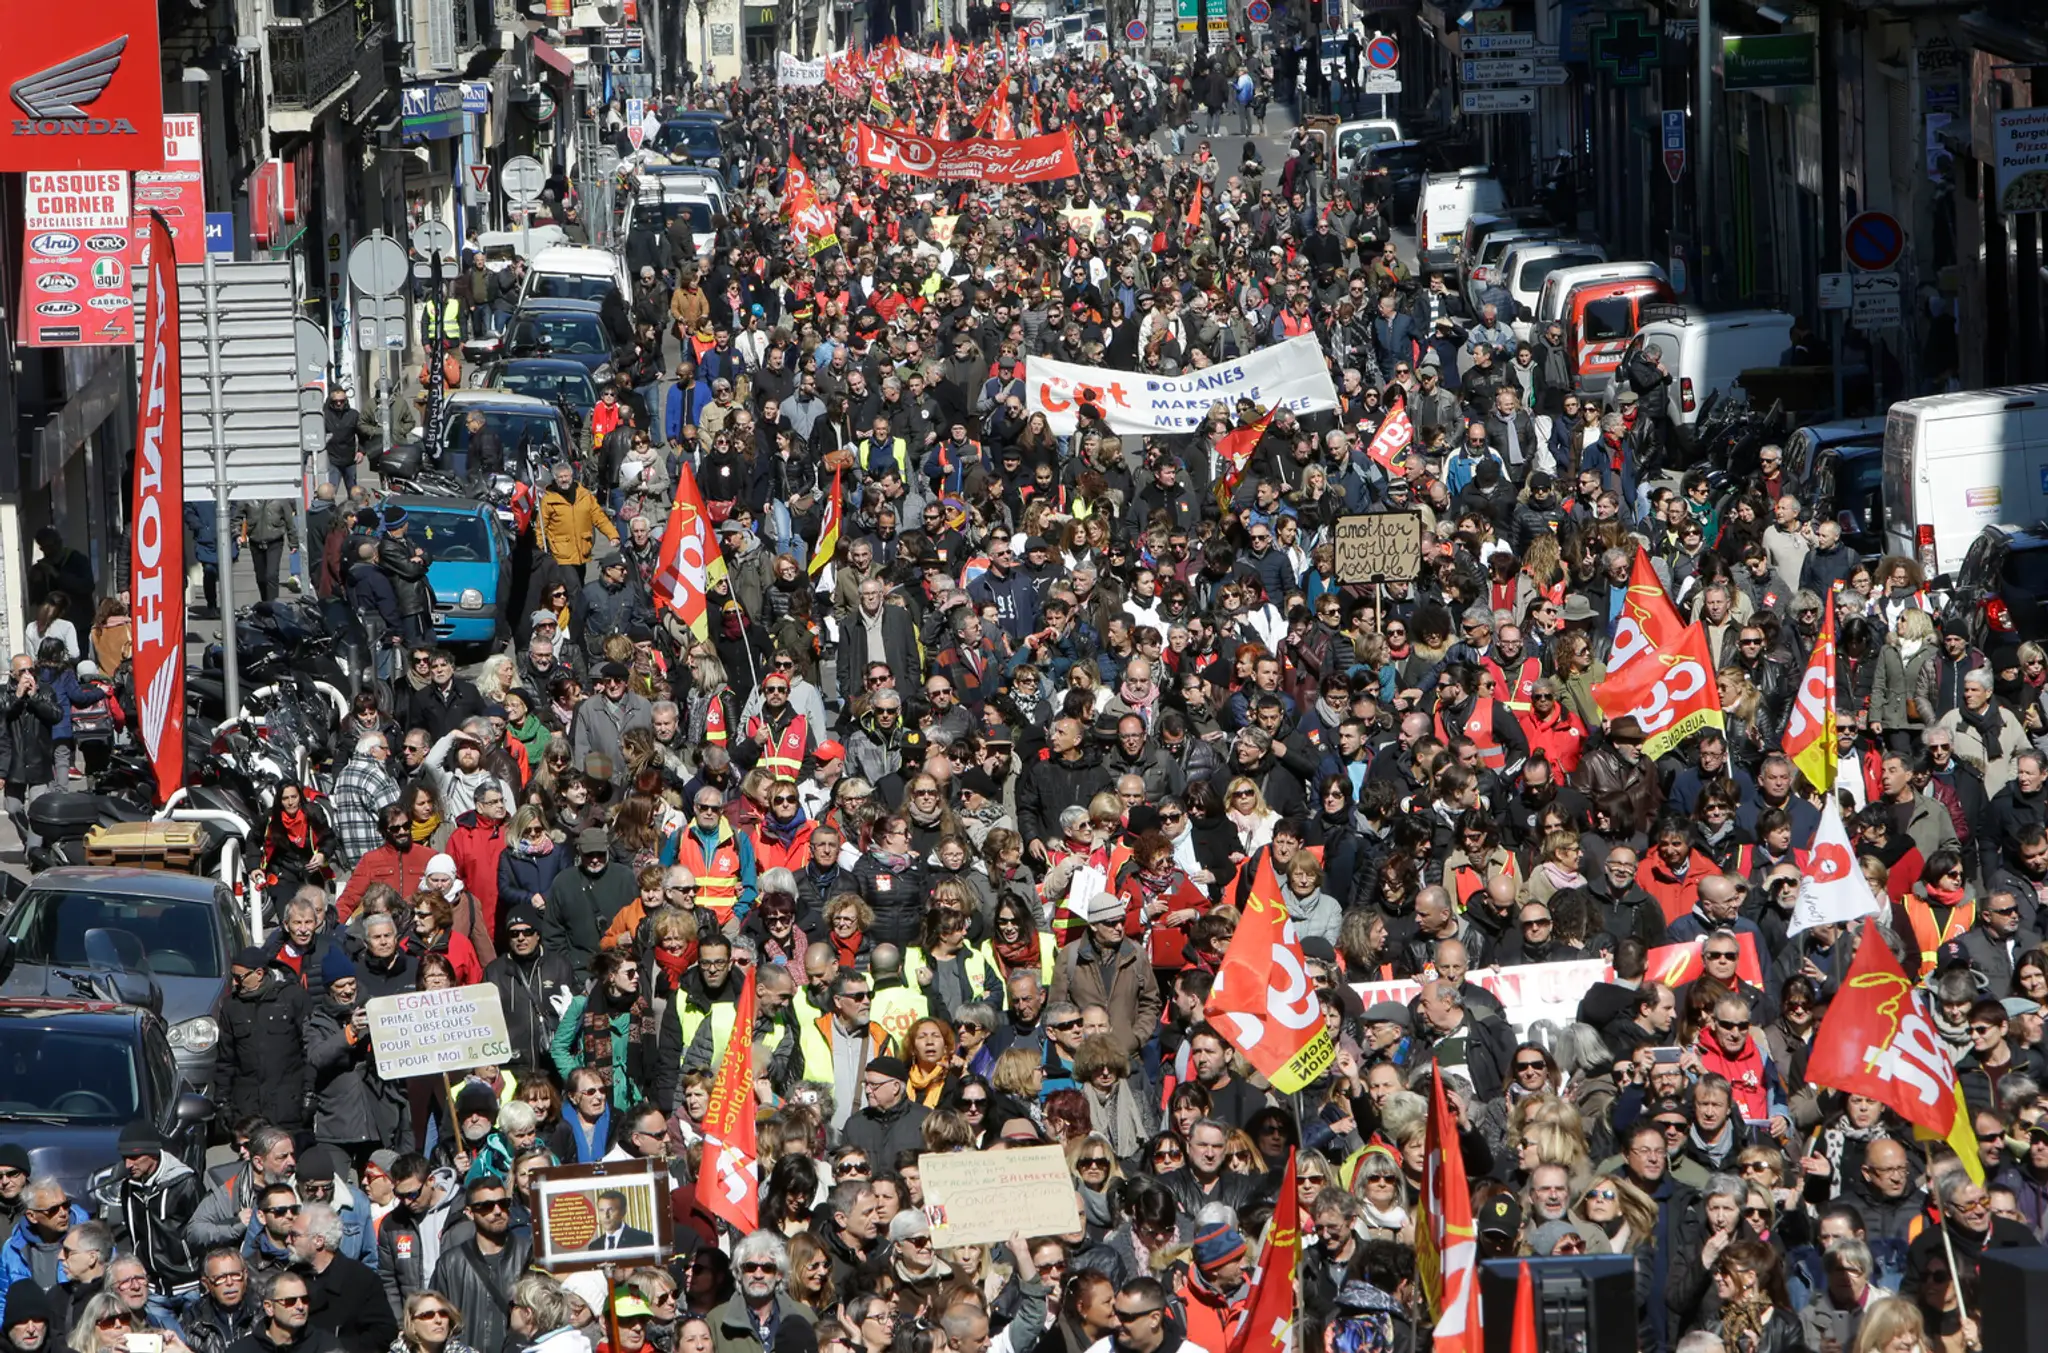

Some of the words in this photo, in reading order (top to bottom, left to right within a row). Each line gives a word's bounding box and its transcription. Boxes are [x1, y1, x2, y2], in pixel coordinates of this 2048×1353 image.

[1491, 37, 1531, 46] Gambetta
[12, 118, 138, 135] HONDA
[1669, 113, 1678, 126] P
[2003, 154, 2040, 167] Poulet
[947, 168, 983, 179] MARSEILLE
[30, 174, 120, 194] CASQUES
[38, 196, 115, 214] CORNER
[41, 235, 73, 248] Arai
[90, 299, 129, 307] CABERG
[1147, 366, 1245, 392] DOUANES
[137, 264, 168, 651] HONDA
[1337, 516, 1413, 540] another
[1339, 535, 1399, 560] world
[1402, 538, 1420, 556] is
[397, 989, 463, 1011] EGALITE
[381, 1013, 415, 1026] PRIME
[425, 1010, 440, 1019] DE
[446, 1003, 476, 1016] FRAIS
[400, 1028, 408, 1037] D
[413, 1016, 472, 1033] OBSEQUES
[380, 1040, 411, 1052] POUR
[418, 1036, 437, 1046] LES
[443, 1027, 492, 1042] DEPUTES
[380, 1061, 392, 1072] ET
[400, 1055, 429, 1067] POUR
[437, 1051, 461, 1062] MOI
[468, 1047, 479, 1060] la
[482, 1041, 509, 1057] CSG
